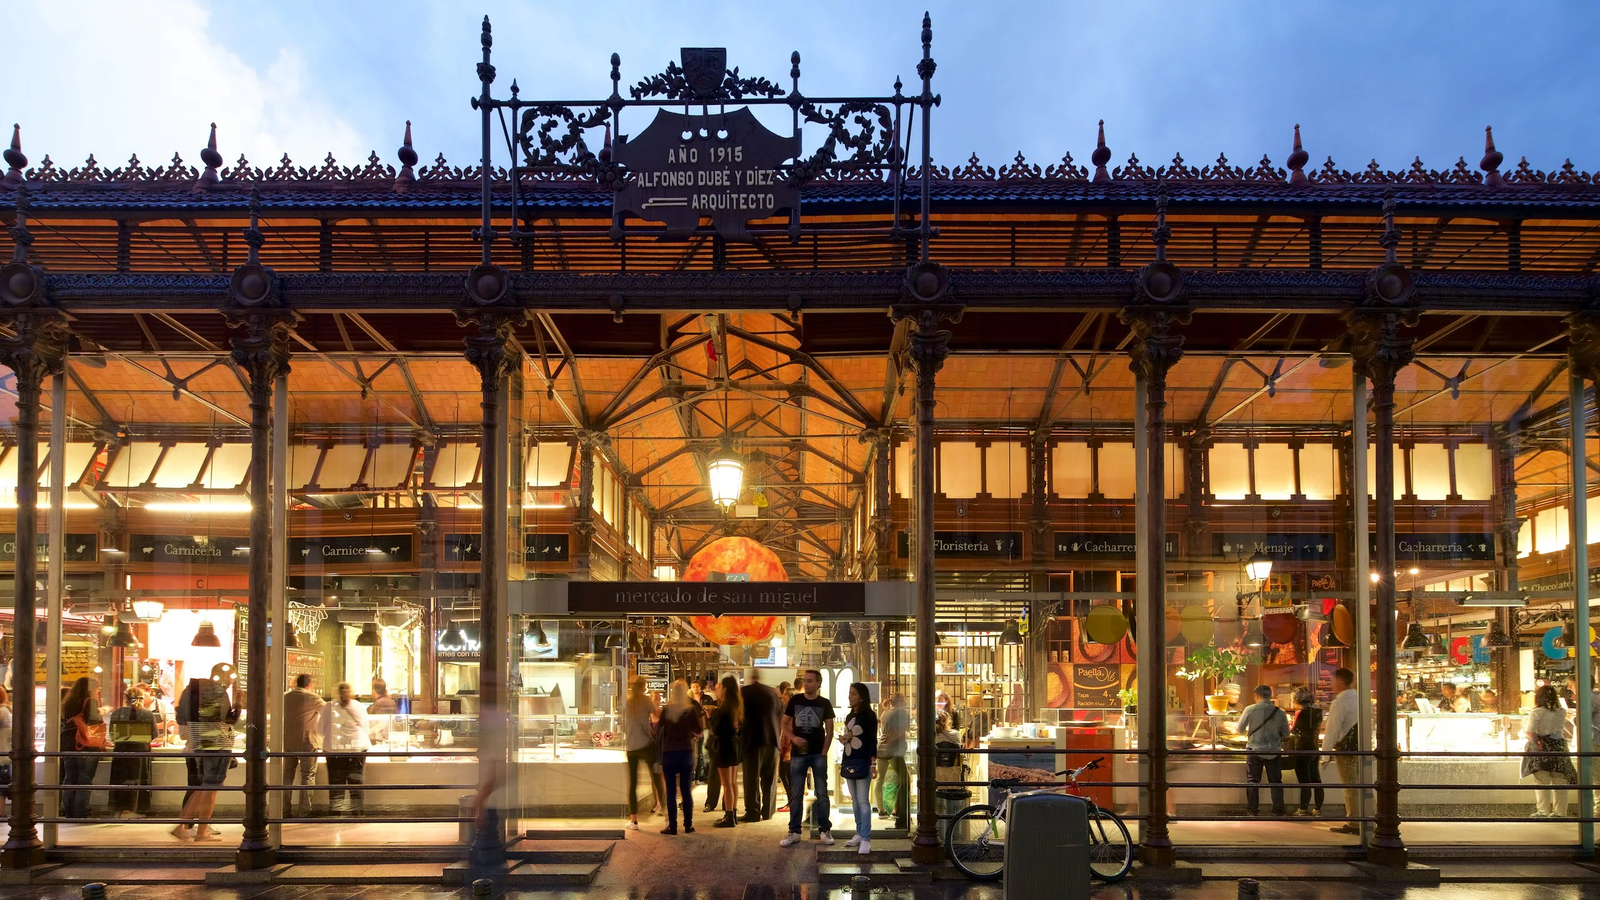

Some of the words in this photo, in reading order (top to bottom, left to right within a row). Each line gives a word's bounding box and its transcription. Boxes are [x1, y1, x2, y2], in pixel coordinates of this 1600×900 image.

[668, 144, 698, 163] AÑO
[709, 146, 743, 163] 1915
[637, 170, 694, 187] ALFONSO
[698, 166, 731, 187] DUBÉ
[734, 170, 742, 186] Y
[164, 544, 222, 557] Carnicería
[933, 540, 989, 552] Floristería
[1253, 541, 1294, 556] Menaje
[1398, 540, 1463, 553] Cacharrería
[615, 587, 692, 604] mercado
[696, 587, 718, 604] de
[722, 591, 754, 604] san
[758, 587, 818, 610] miguel
[1077, 667, 1102, 678] Paella
